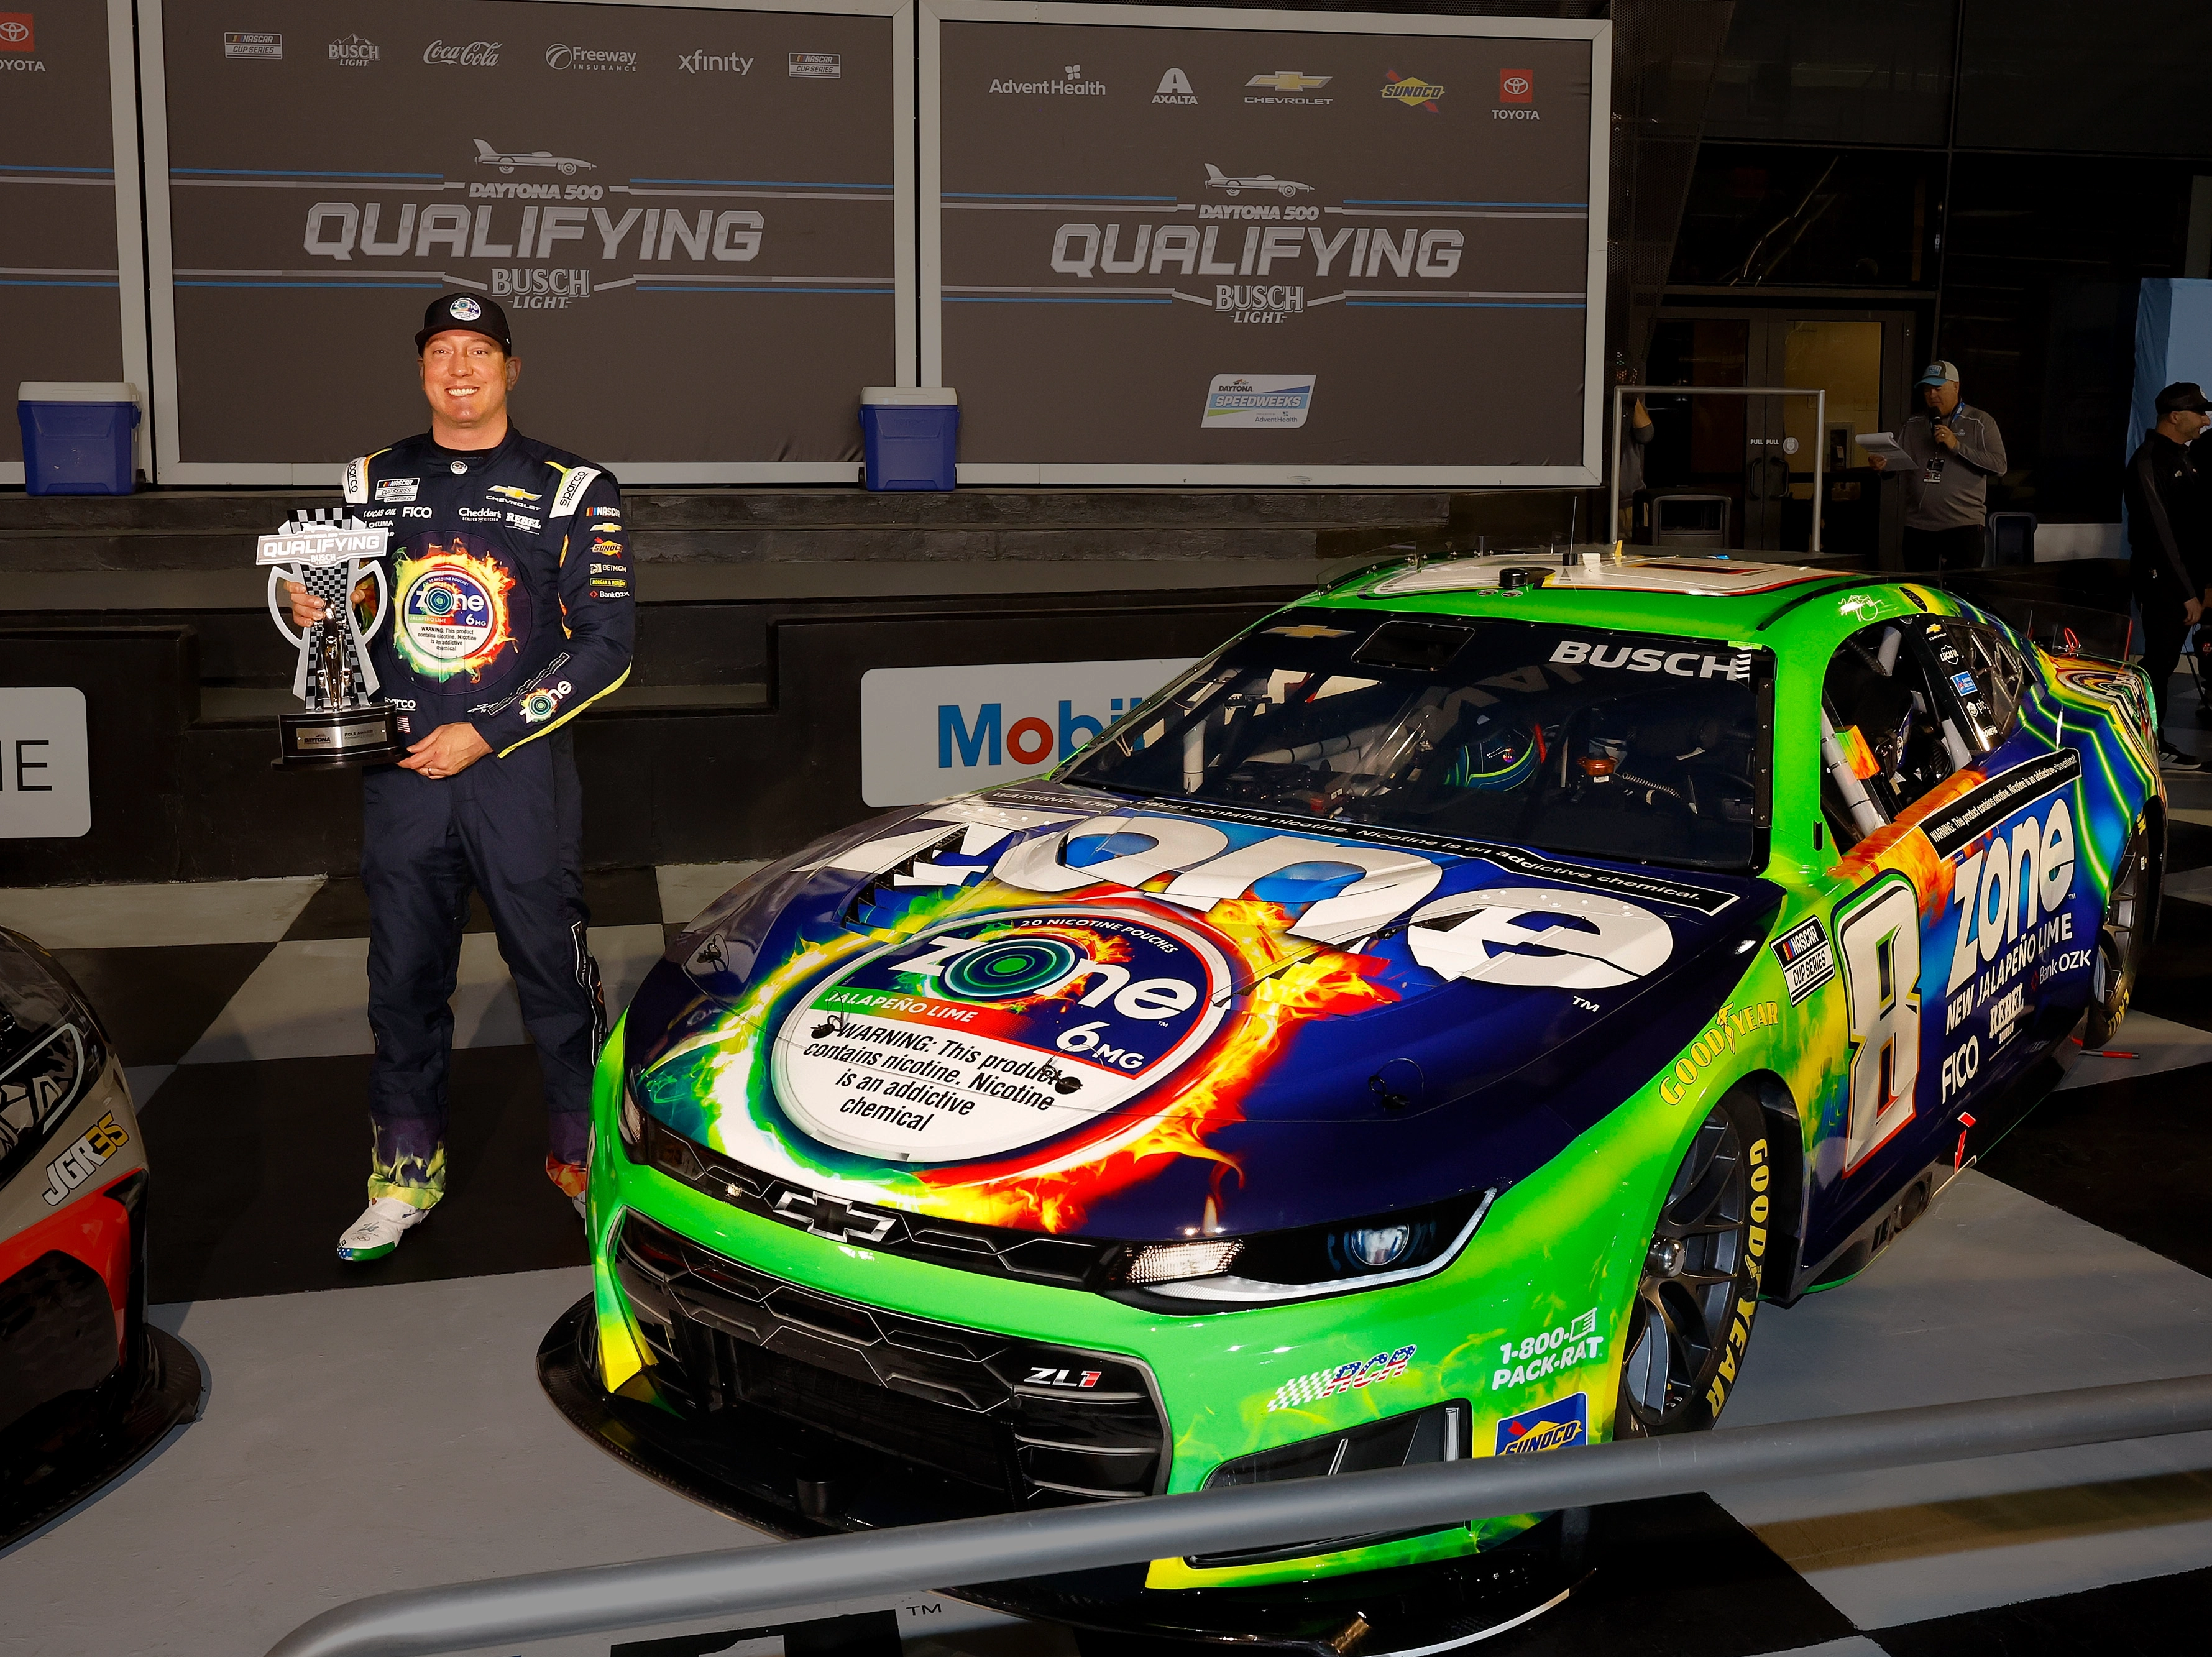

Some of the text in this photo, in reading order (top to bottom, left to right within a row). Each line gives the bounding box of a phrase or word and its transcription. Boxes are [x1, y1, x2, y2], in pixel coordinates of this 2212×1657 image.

[242, 35, 273, 43] NASCAR
[328, 44, 380, 61] BUSCH
[0, 60, 45, 72] OYOTA
[423, 40, 503, 67] Coca-Cola
[573, 47, 637, 65] Freeway
[678, 49, 754, 76] xfinity
[1151, 94, 1198, 104] AXALTA
[1383, 85, 1442, 98] SUNOCO
[1492, 109, 1540, 120] TOYOTA
[469, 183, 603, 200] DAYTONA 500
[1198, 205, 1319, 221] DAYTONA 500
[303, 202, 764, 261] QUALIFYING
[1050, 223, 1465, 278] QUALIFYING
[491, 268, 590, 298] BUSCH
[512, 296, 569, 309] LIGHT
[1215, 284, 1304, 313] BUSCH
[1233, 311, 1285, 323] LIGHT
[1215, 395, 1301, 408] SPEEDWEEKS
[560, 470, 586, 507] sparco
[364, 508, 384, 518] LUCAS
[402, 506, 433, 518] FICO
[485, 495, 541, 511] CHEVROLET
[597, 507, 620, 518] NASCAR
[505, 512, 541, 529] REBEL
[263, 535, 380, 558] QUALIFYING
[310, 553, 336, 563] BUSCH
[602, 564, 627, 572] BETMGM
[452, 577, 469, 587] POUCHES
[415, 587, 484, 614] zone
[1549, 640, 1739, 681] BUSCH
[518, 681, 572, 723] zone
[1930, 821, 1957, 843] WARNING:
[1951, 815, 1965, 829] This
[1962, 806, 1980, 826] product
[1976, 798, 1996, 814] contains
[2006, 781, 2027, 795] Nicotine
[991, 791, 1076, 805] WARNING:
[1084, 799, 1118, 809] This
[1137, 799, 1190, 811] oduct
[1190, 806, 1269, 822] contains
[1270, 817, 1350, 833] nicotine.
[1356, 829, 1438, 847] Nicotine
[1465, 846, 1492, 855] an
[1496, 850, 1592, 879] addictive
[1597, 876, 1700, 901] chemical.
[790, 806, 1673, 988] zone
[1945, 799, 2075, 998] zone
[1020, 918, 1179, 954] 20 NICOTINE POUCHES
[1790, 925, 1819, 955] NASCAR
[888, 937, 1198, 1021] zone
[1792, 950, 1827, 987] CUP SERIES
[1946, 912, 2073, 1036] NEW JALAPEÑO LIME
[824, 992, 980, 1023] JALAPEÑO LIME
[1572, 996, 1600, 1012] TM
[1989, 982, 2024, 1039] REBEL
[1157, 1020, 1169, 1028] TM
[1831, 871, 1920, 1178] 8
[839, 1022, 1063, 1085] WARNING: This product
[804, 1042, 1055, 1111] contains nicotine. Nicotine
[1942, 1035, 1979, 1104] FICO
[836, 1068, 975, 1116] is an addictive
[840, 1098, 934, 1132] chemical
[1321, 1344, 1418, 1397] RCR
[1492, 1336, 1604, 1390] PACK-RAT
[1024, 1367, 1102, 1387] ZL1
[906, 1603, 942, 1616] TM
